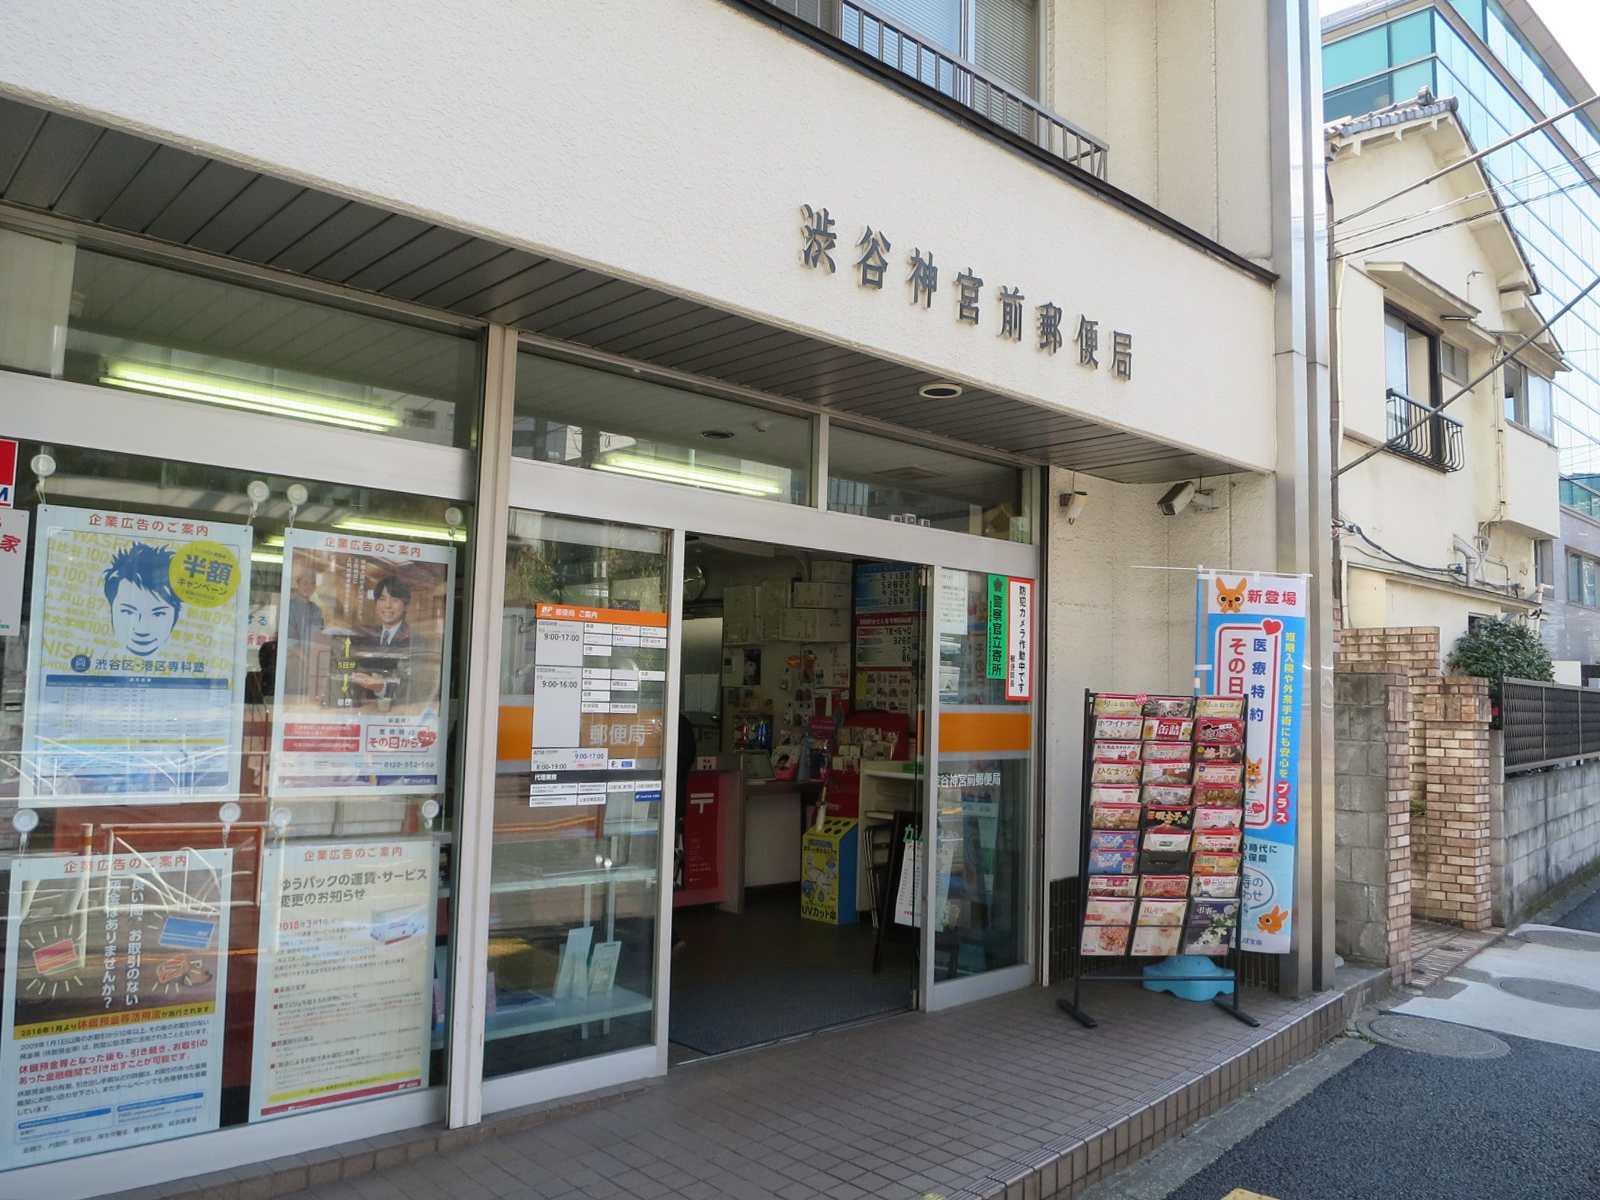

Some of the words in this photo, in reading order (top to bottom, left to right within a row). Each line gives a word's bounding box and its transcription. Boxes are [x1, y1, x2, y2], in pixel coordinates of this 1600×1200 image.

[800, 203, 1133, 381] 渋谷神宮前郵便局
[88, 513, 209, 537] 企業広告のご案内
[325, 537, 421, 557] 企業広告のご案内
[183, 554, 234, 587] 半額
[178, 578, 228, 596] キャンペーン
[1247, 589, 1297, 606] 新登場
[544, 632, 580, 642] 9:00-17:00
[992, 594, 1003, 677] 警察官立寄所
[1017, 585, 1027, 694] 防犯カメラ作動中です
[95, 658, 205, 673] 渋谷区・港区専科塾
[337, 661, 356, 669] 5日分
[1228, 637, 1247, 695] その日
[542, 680, 578, 689] 9:00-16:00
[1248, 638, 1268, 722] 医療特約
[1279, 632, 1297, 779] 短期入院や外来手術にも安心を
[589, 723, 647, 747] 郵便局
[1157, 724, 1180, 736] 缶詰
[1097, 767, 1135, 777] ひなまつり
[1275, 783, 1290, 822] プラス
[304, 846, 403, 862] 企業広告のご案内
[63, 855, 188, 874] 企業広告のご案内
[281, 869, 428, 892] ゆうパックの運賃・サービス
[280, 888, 366, 908] 変更のお知らせ
[801, 905, 837, 920] UVカット傘
[125, 878, 146, 1006] 長い間、お取引のない
